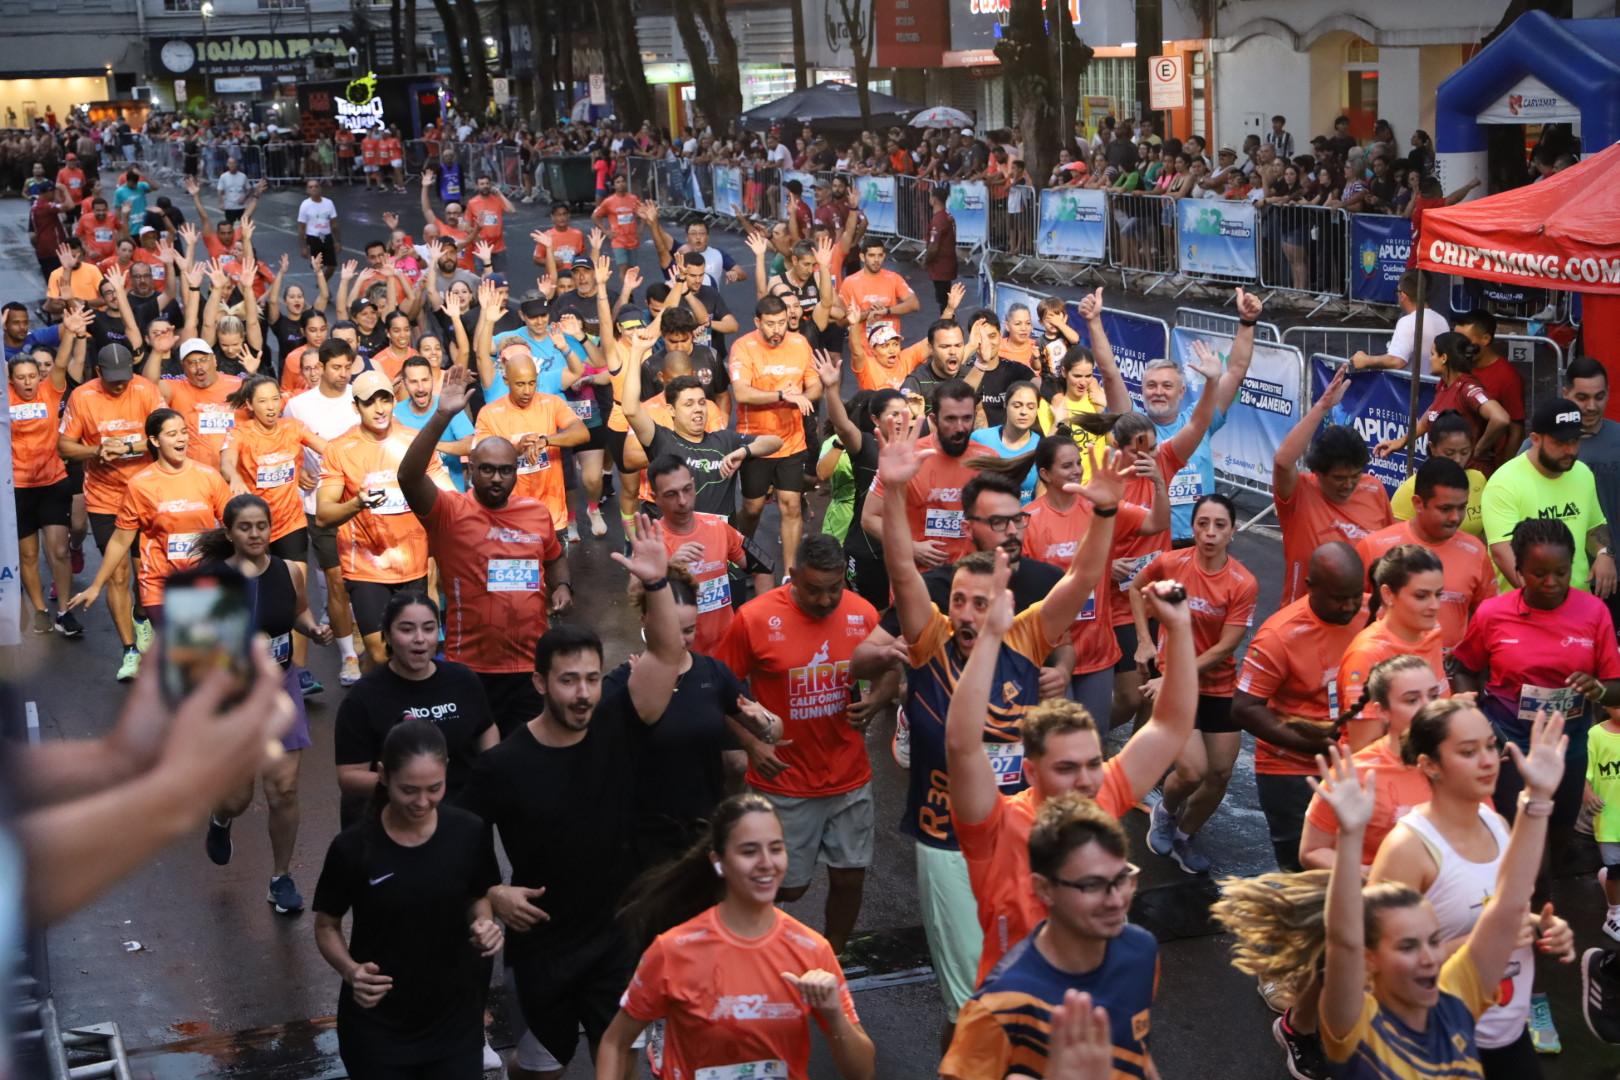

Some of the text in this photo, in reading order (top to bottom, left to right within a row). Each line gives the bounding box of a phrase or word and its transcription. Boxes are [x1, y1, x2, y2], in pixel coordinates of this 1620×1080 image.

[1161, 63, 1171, 77] E
[1256, 394, 1292, 415] JANEIRO
[264, 469, 290, 482] 6692
[935, 517, 961, 530] 638
[494, 569, 533, 582] 6424
[430, 702, 457, 719] giro
[1598, 760, 1620, 777] MY
